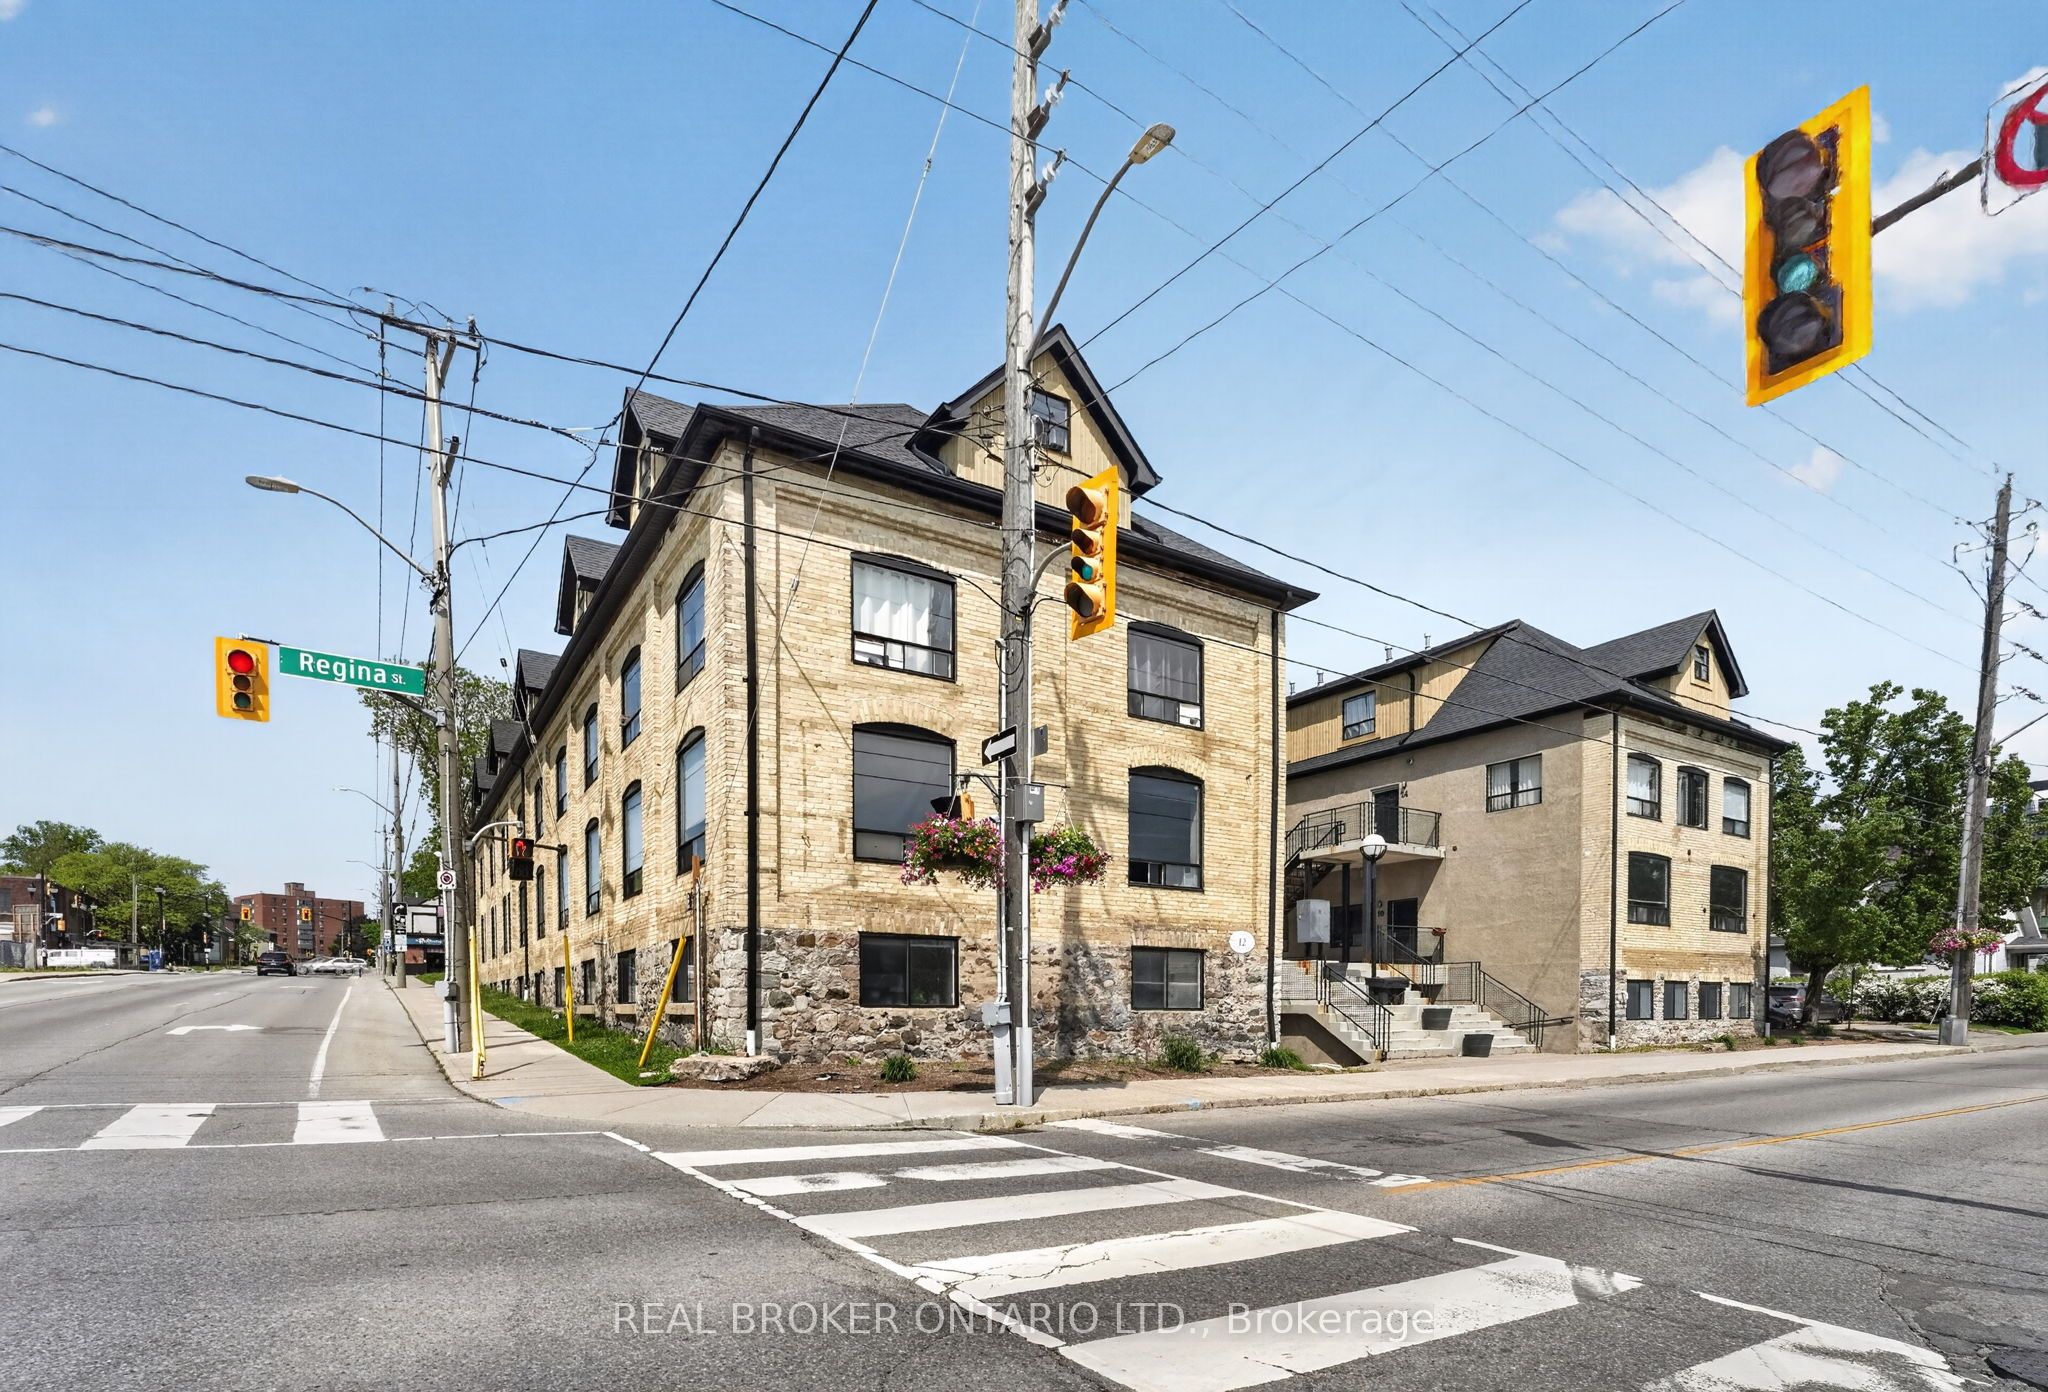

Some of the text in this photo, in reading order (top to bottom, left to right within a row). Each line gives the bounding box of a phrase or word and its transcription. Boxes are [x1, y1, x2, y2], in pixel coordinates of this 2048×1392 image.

[299, 653, 406, 685] Regina St.
[1238, 937, 1247, 947] 12
